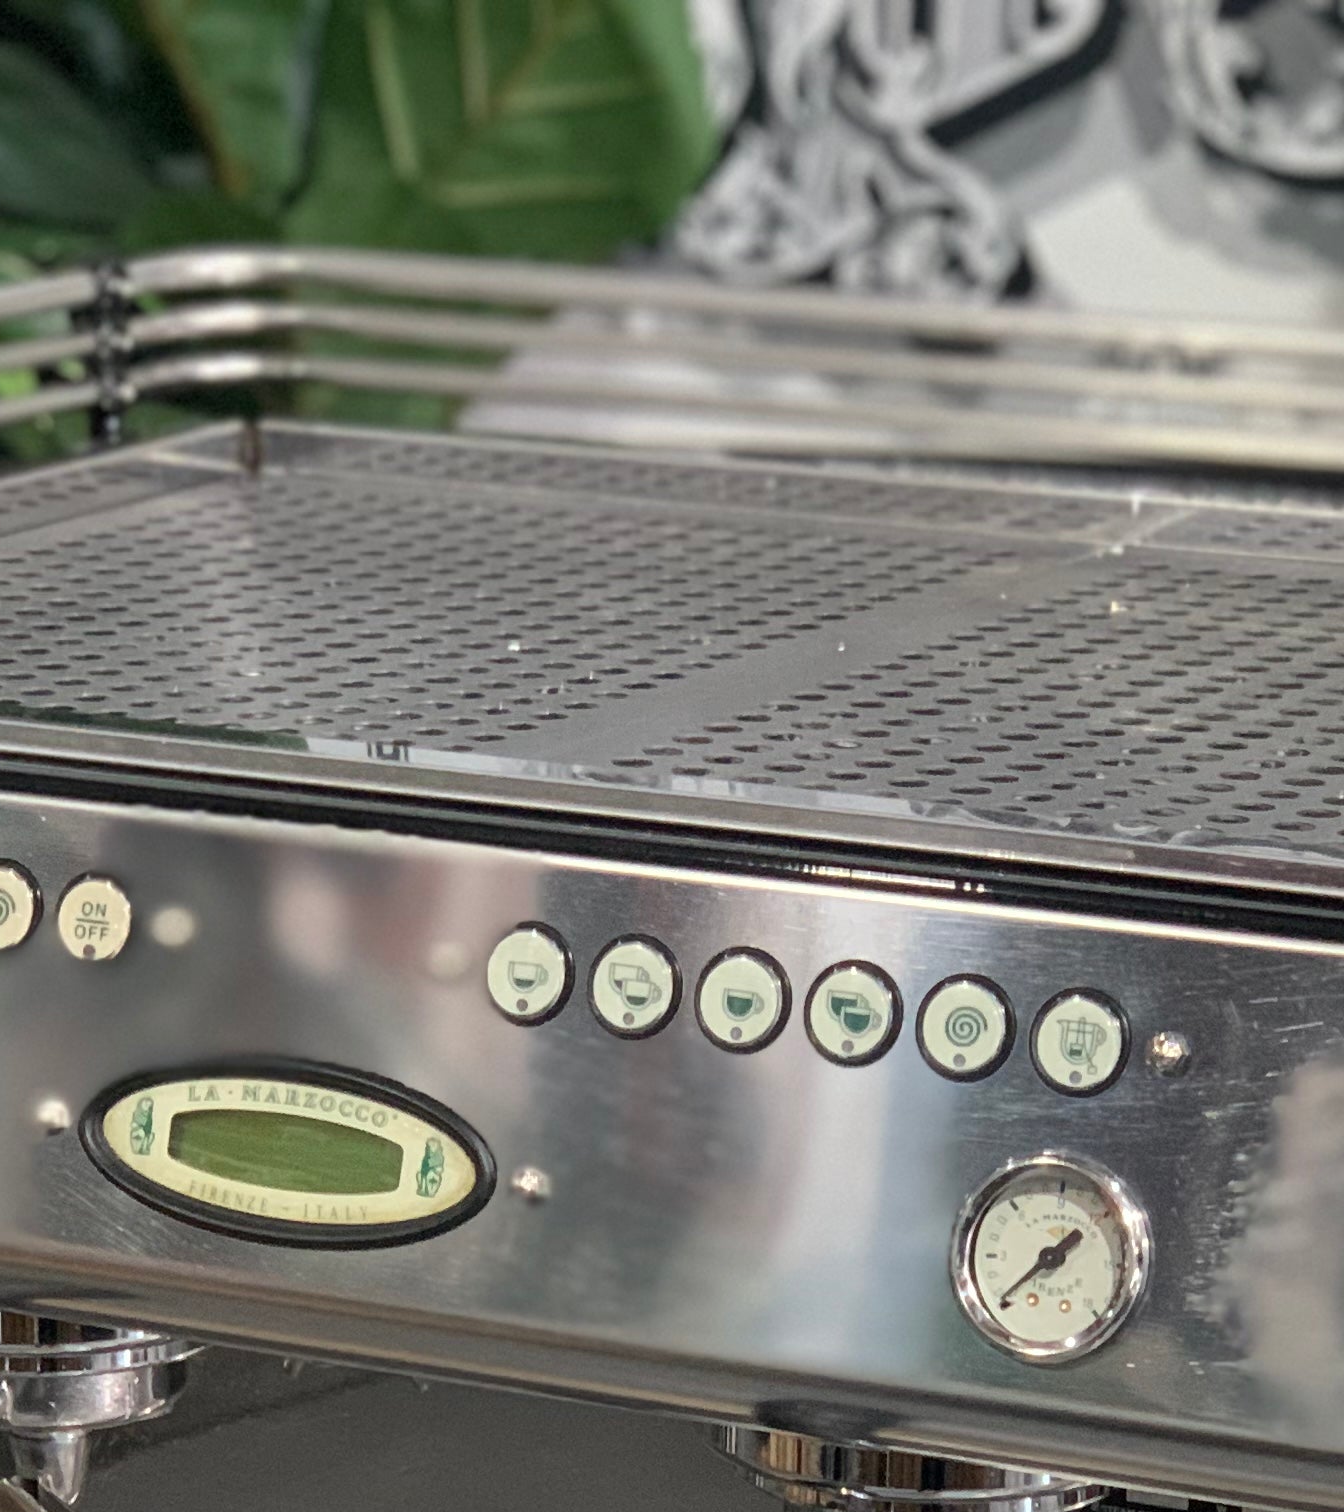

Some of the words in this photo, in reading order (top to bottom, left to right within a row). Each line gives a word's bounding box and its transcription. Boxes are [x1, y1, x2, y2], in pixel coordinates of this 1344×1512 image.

[81, 900, 109, 918] ON
[73, 923, 111, 942] OFF
[186, 1084, 221, 1103] LA
[241, 1085, 390, 1129] MARZOCCO
[186, 1179, 269, 1216] FIRENZE
[301, 1202, 370, 1223] ITALY
